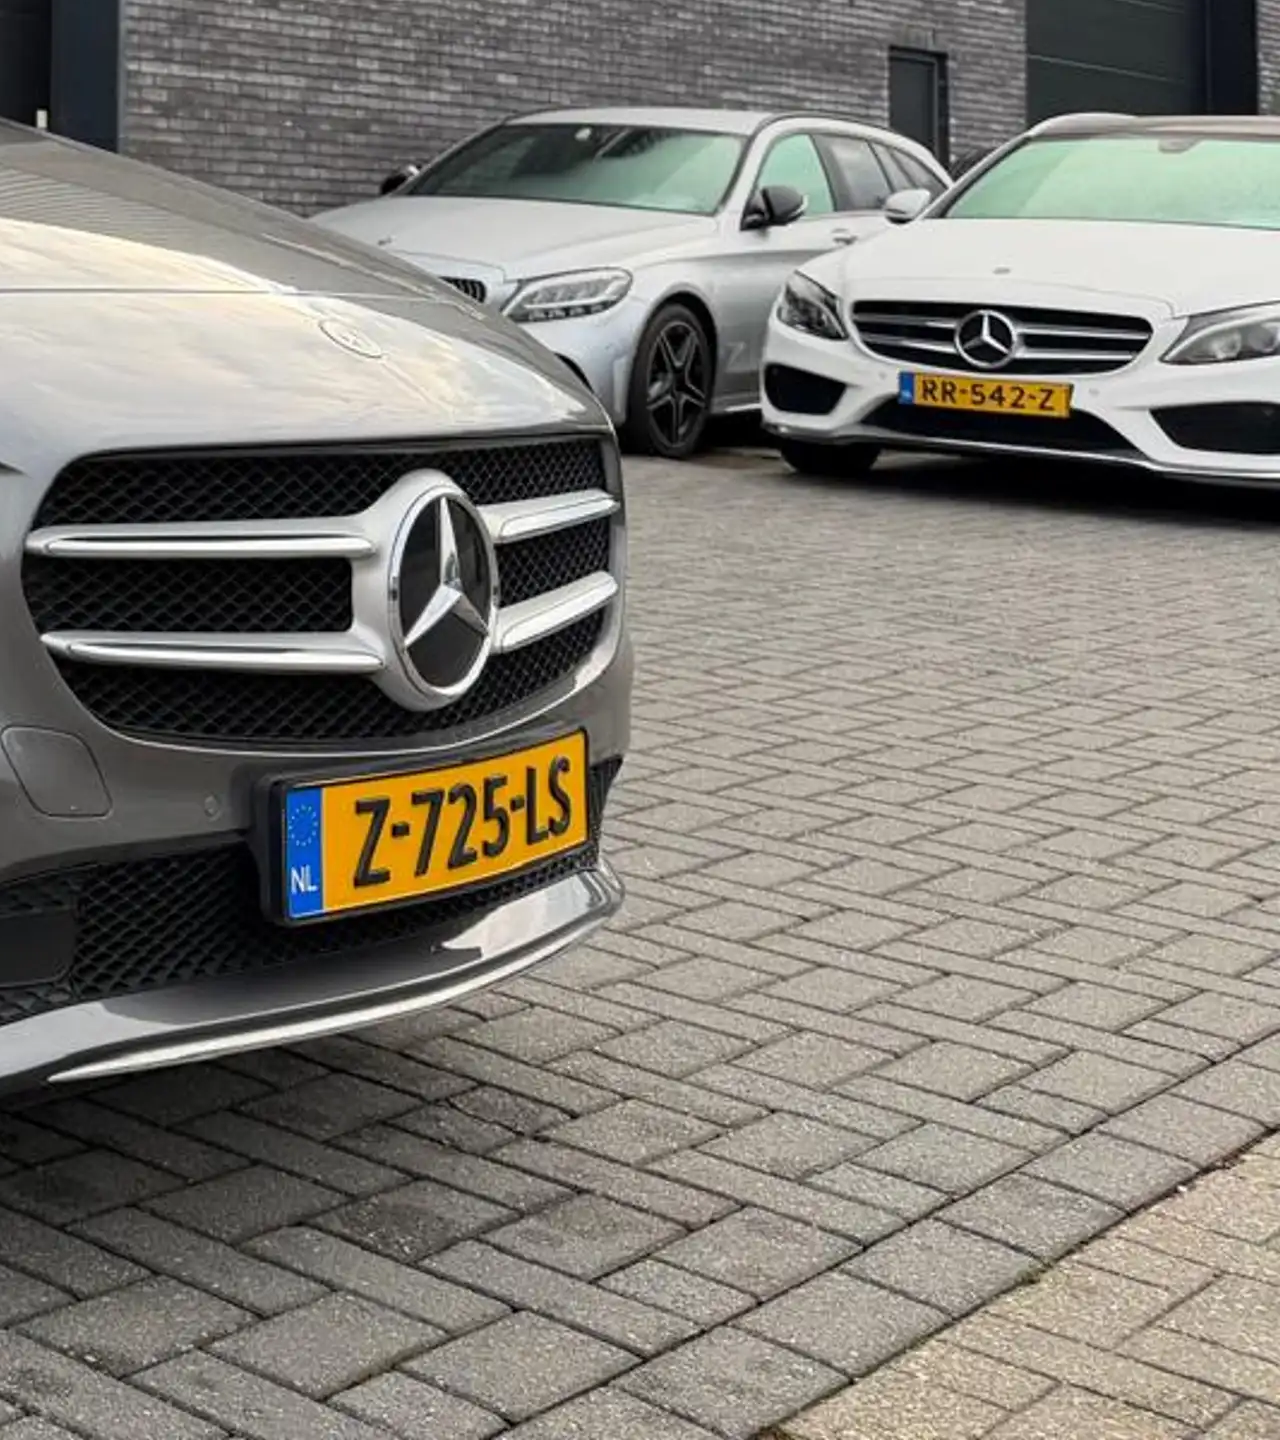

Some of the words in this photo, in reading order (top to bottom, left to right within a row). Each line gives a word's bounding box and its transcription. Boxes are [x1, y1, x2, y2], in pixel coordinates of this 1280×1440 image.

[921, 378, 1056, 412] RR-542-Z
[352, 755, 572, 890] Z-725-LS
[290, 864, 319, 895] NL
